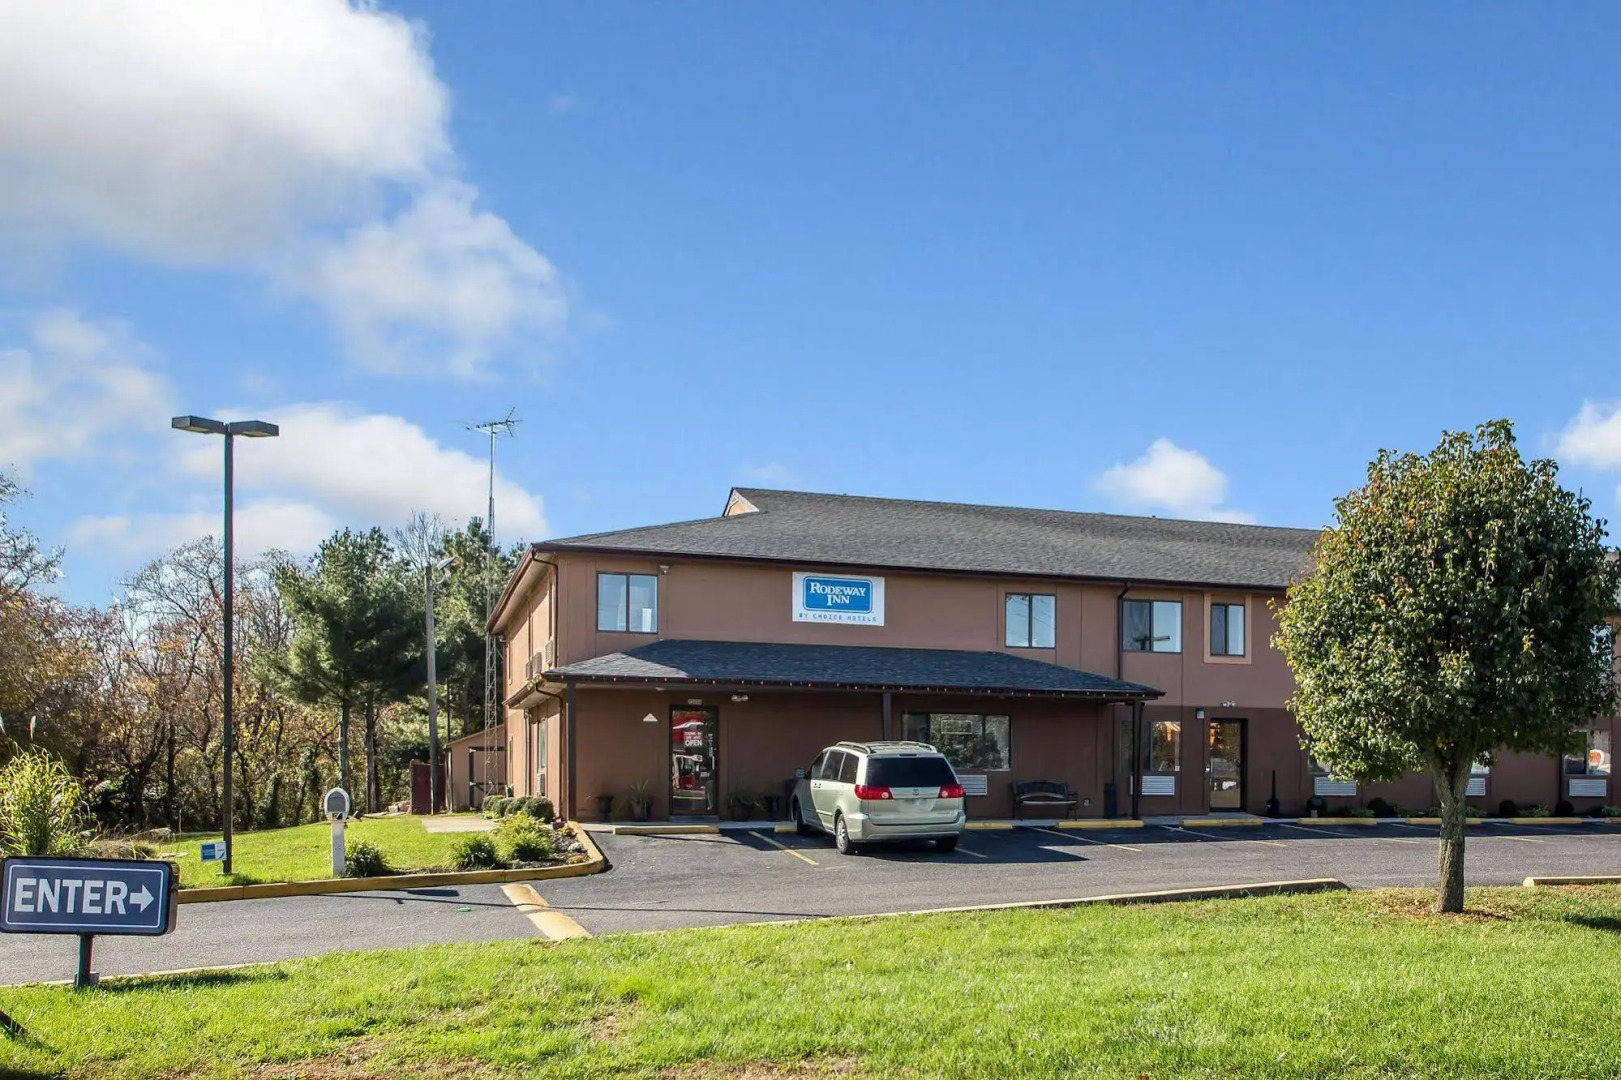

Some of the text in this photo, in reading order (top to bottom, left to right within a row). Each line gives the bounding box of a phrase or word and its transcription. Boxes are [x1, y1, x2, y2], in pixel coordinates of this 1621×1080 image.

[809, 582, 866, 597] RODEWAY
[826, 594, 850, 606] INN
[14, 877, 128, 915] ENTER
